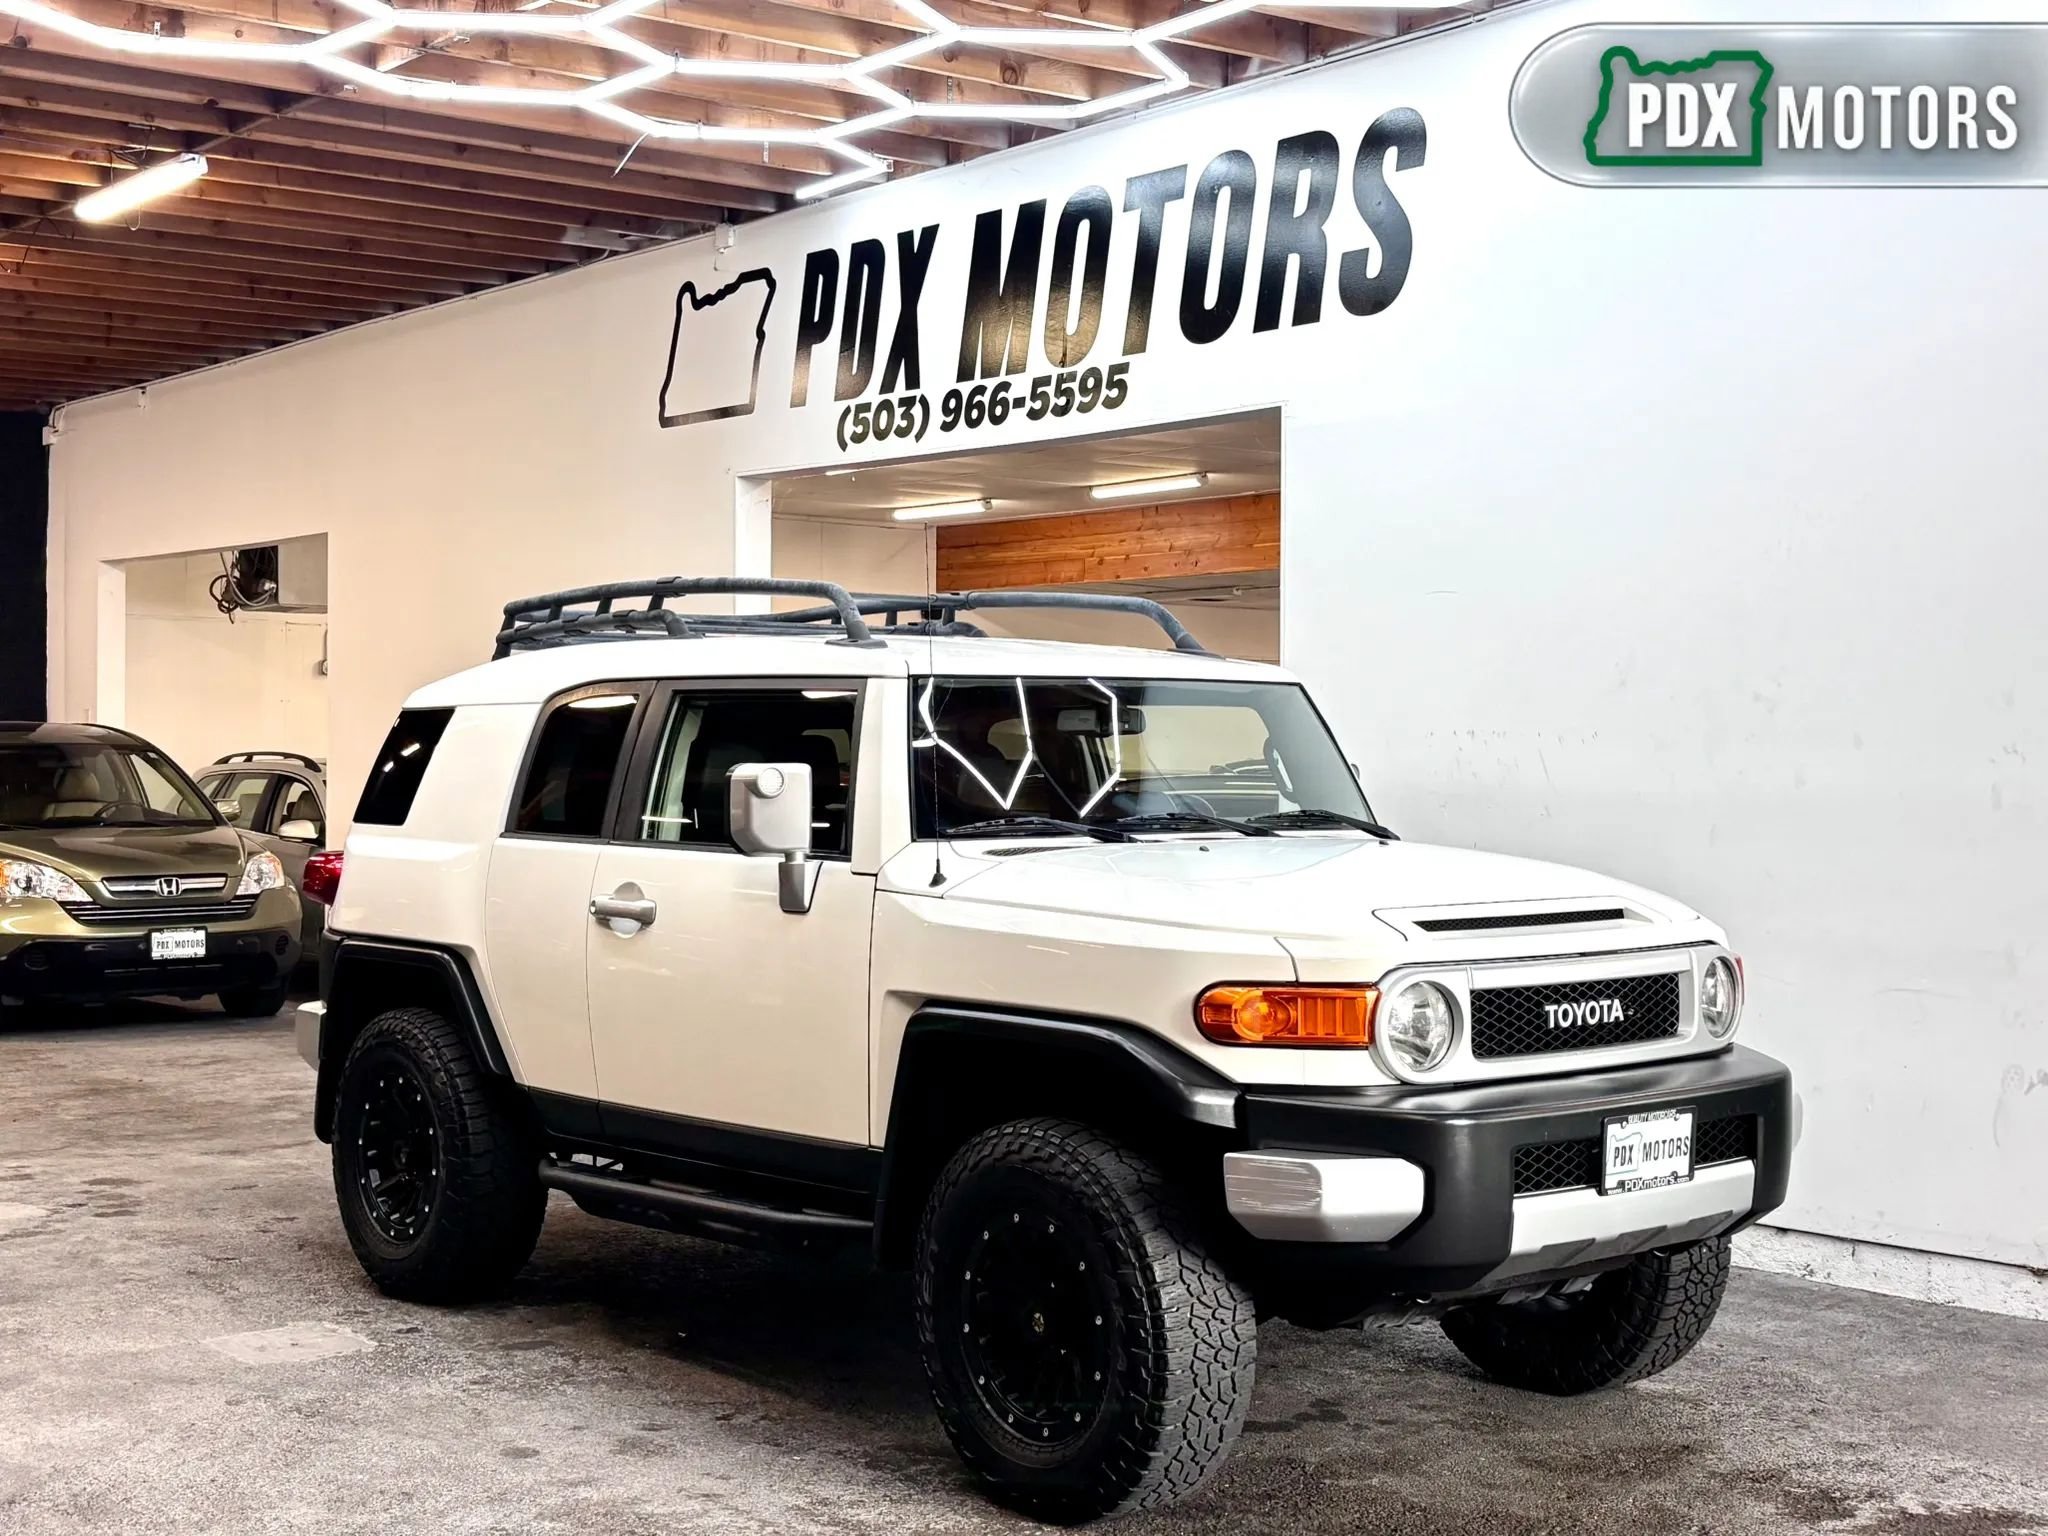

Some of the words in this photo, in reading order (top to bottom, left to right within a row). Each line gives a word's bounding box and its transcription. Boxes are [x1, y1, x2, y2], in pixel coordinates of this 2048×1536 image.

[790, 223, 940, 408] PDX
[956, 106, 1428, 382] MOTORS
[837, 393, 931, 452] (503)
[940, 361, 1131, 432] 966-5595
[156, 940, 170, 950] PDX
[174, 939, 205, 949] MOTORS
[1544, 998, 1625, 1030] TOYOTA
[1613, 1143, 1634, 1168] PDX
[1642, 1136, 1690, 1163] MOTORS
